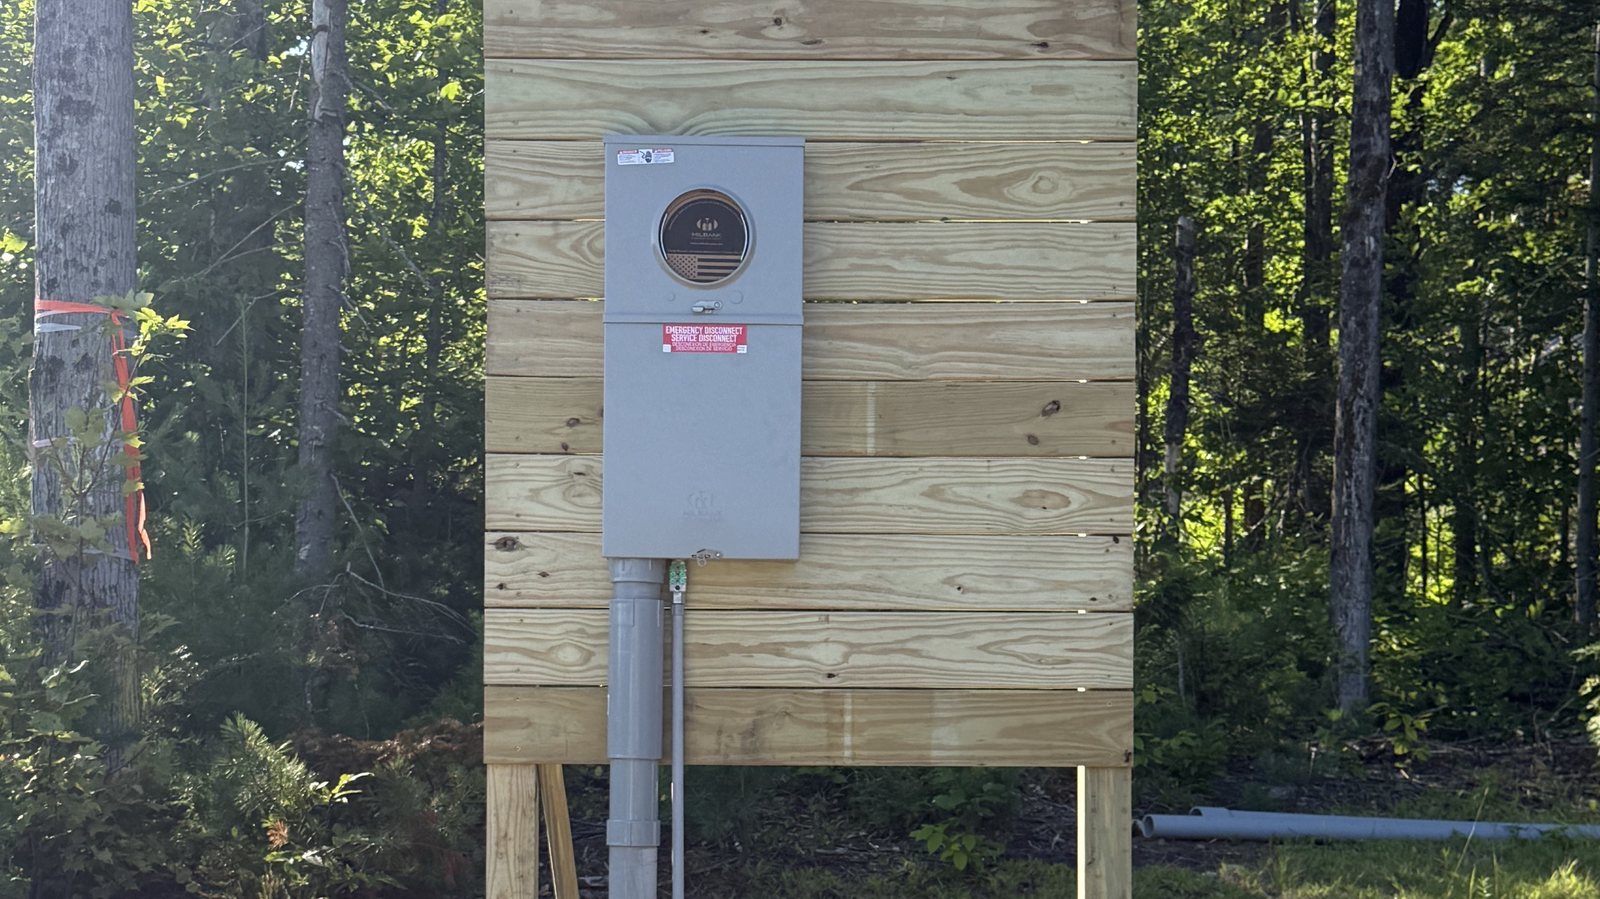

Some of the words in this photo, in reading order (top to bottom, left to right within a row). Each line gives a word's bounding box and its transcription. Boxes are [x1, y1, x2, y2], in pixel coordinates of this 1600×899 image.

[665, 326, 703, 335] EMERGENCY
[704, 326, 743, 335] DISCONNECT
[671, 334, 698, 342] SERVICE
[698, 334, 737, 343] DISCONNECT
